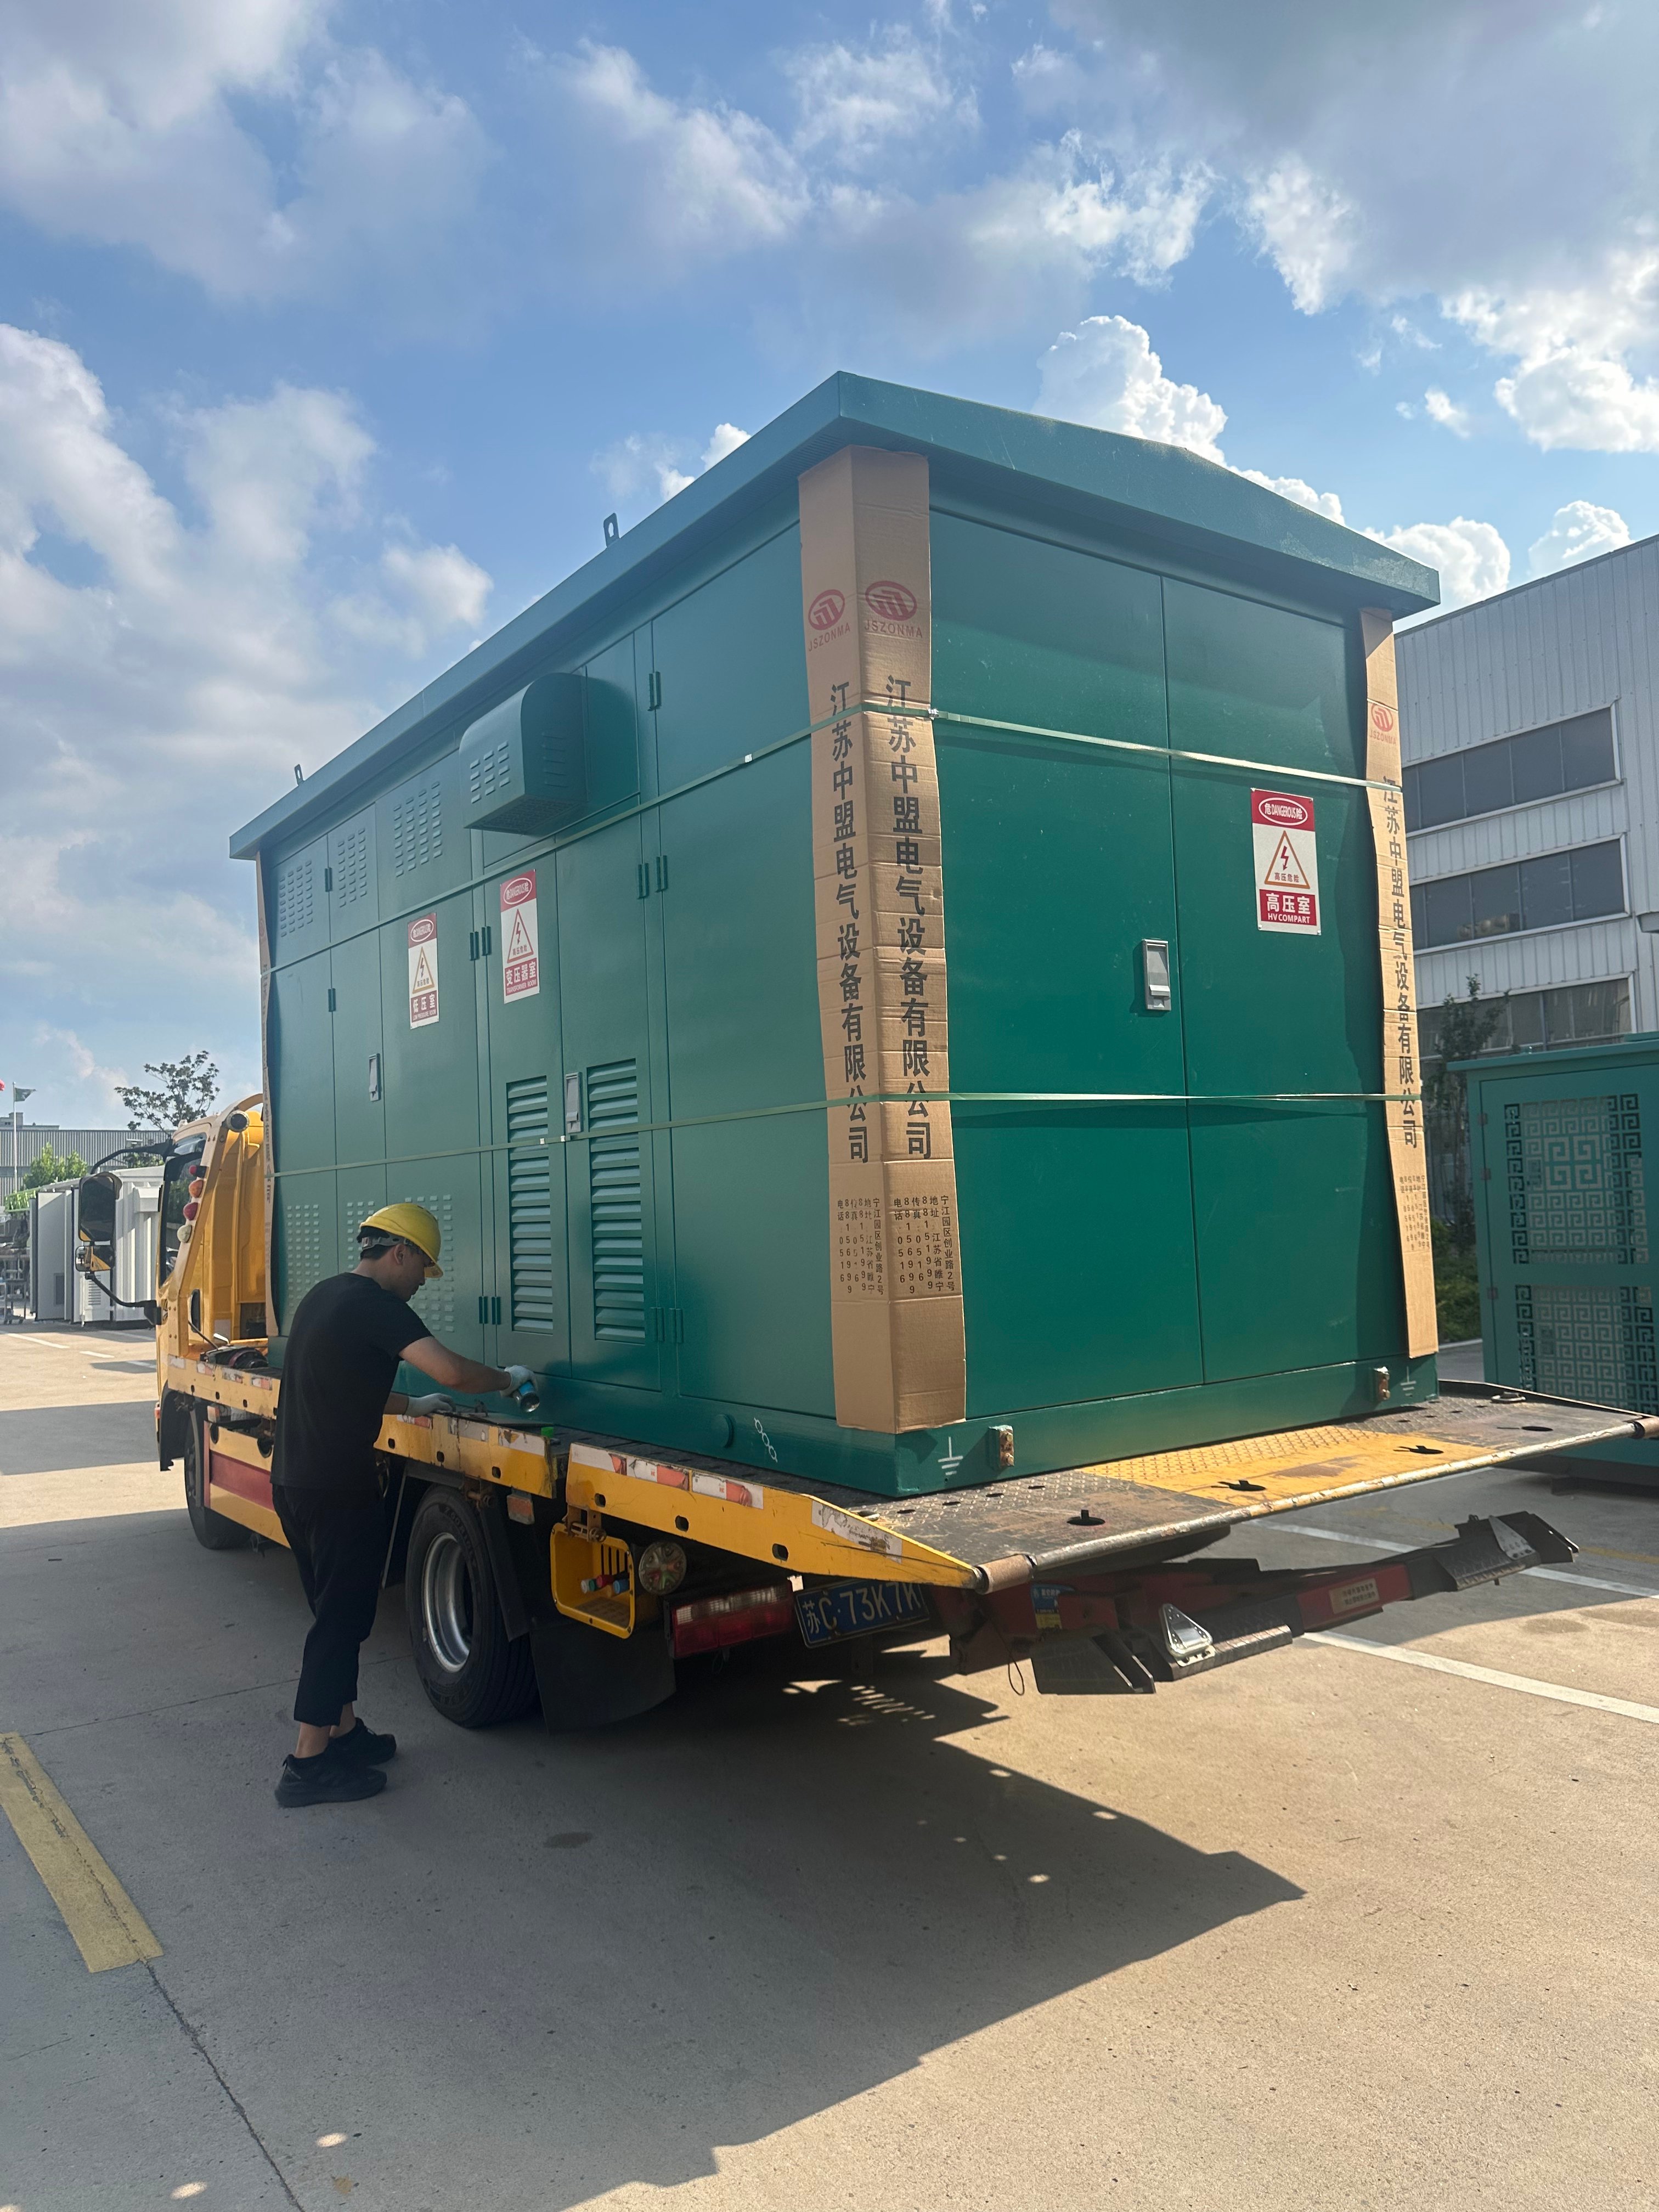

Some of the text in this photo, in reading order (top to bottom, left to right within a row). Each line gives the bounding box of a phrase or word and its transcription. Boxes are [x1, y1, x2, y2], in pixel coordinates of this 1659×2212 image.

[808, 622, 851, 652] JSZONMA
[864, 619, 923, 639] JSZONMA
[1274, 872, 1299, 883] 高压危险
[1266, 893, 1311, 915] 高压室
[830, 681, 869, 1164] 江苏中盟电气设备有限公司
[885, 674, 932, 1160] 江苏中盟电气设备有限公司
[1268, 912, 1310, 924] HV COMPART
[1383, 775, 1417, 1148] 江苏中盟电气设备有限公司
[506, 961, 537, 986] 变压器室
[413, 993, 435, 1013] 低压室
